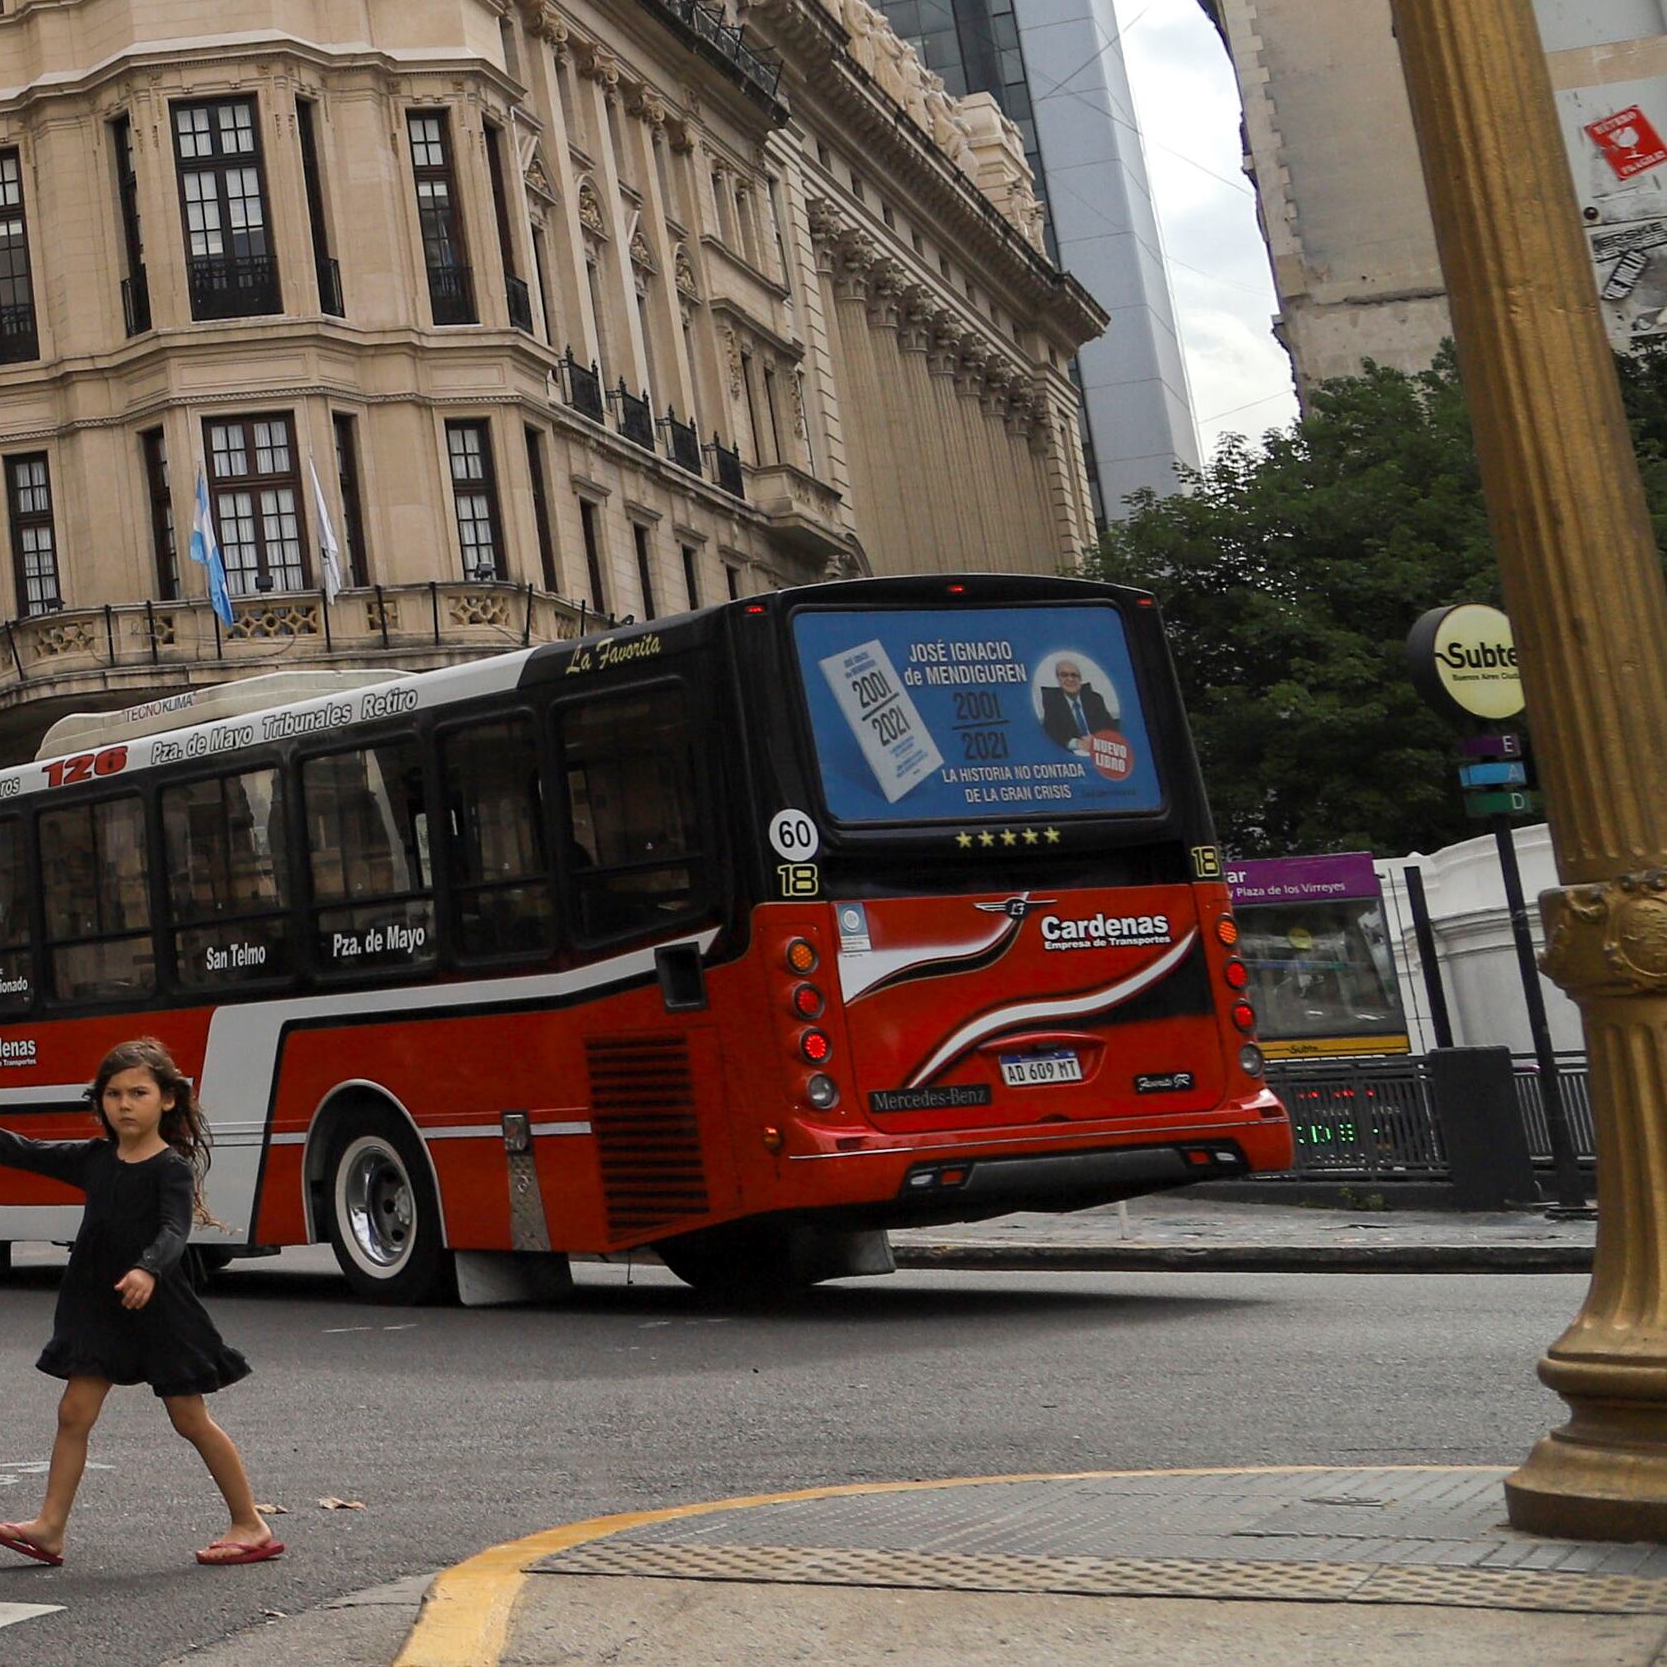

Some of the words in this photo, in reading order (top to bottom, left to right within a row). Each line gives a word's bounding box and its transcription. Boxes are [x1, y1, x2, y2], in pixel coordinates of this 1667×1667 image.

[565, 643, 592, 675] La
[596, 633, 662, 670] Favorita
[909, 638, 948, 663] JOSÉ
[950, 641, 1013, 662] IGNACIO
[1448, 641, 1518, 669] Subte
[904, 667, 923, 686] de
[925, 663, 1028, 685] MENDIGUREN
[851, 669, 893, 709] 2001
[952, 690, 1003, 721] 2001
[151, 741, 184, 765] Pza.
[186, 735, 206, 758] de
[209, 725, 254, 752] Mayo
[262, 703, 352, 740] Tribunales
[360, 688, 418, 719] Retiro
[871, 705, 911, 748] 2021
[960, 730, 1009, 761] 2021
[1093, 737, 1127, 758] NUEVO
[1502, 734, 1514, 753] E
[42, 745, 129, 788] 126
[942, 768, 958, 783] LA
[959, 765, 1011, 782] HISTORIA
[1015, 764, 1031, 780] NO
[1033, 762, 1085, 779] CONTADA
[1095, 752, 1126, 773] LIBRO
[965, 787, 981, 803] DE
[983, 787, 998, 802] LA
[1001, 785, 1031, 802] GRAN
[1035, 784, 1072, 800] CRISIS
[1511, 792, 1525, 810] D
[779, 819, 811, 849] 60
[1190, 845, 1221, 878] 18
[777, 863, 819, 897] 18
[1237, 887, 1265, 897] Plaza
[1268, 885, 1282, 896] de
[1284, 883, 1300, 894] los
[1301, 881, 1346, 894] Virreyes
[333, 933, 362, 958] Pza.
[365, 928, 383, 954] de
[386, 924, 425, 954] Mayo
[1040, 913, 1169, 941] Cardenas
[206, 946, 228, 971] San
[230, 942, 266, 967] Telmo
[1044, 939, 1091, 951] Empresa
[1093, 938, 1107, 948] de
[1108, 935, 1171, 947] Transportes
[1008, 1062, 1024, 1083] AD
[1029, 1060, 1054, 1081] 609
[1059, 1059, 1077, 1078] MT
[873, 1086, 987, 1111] Mercedes-Benz
